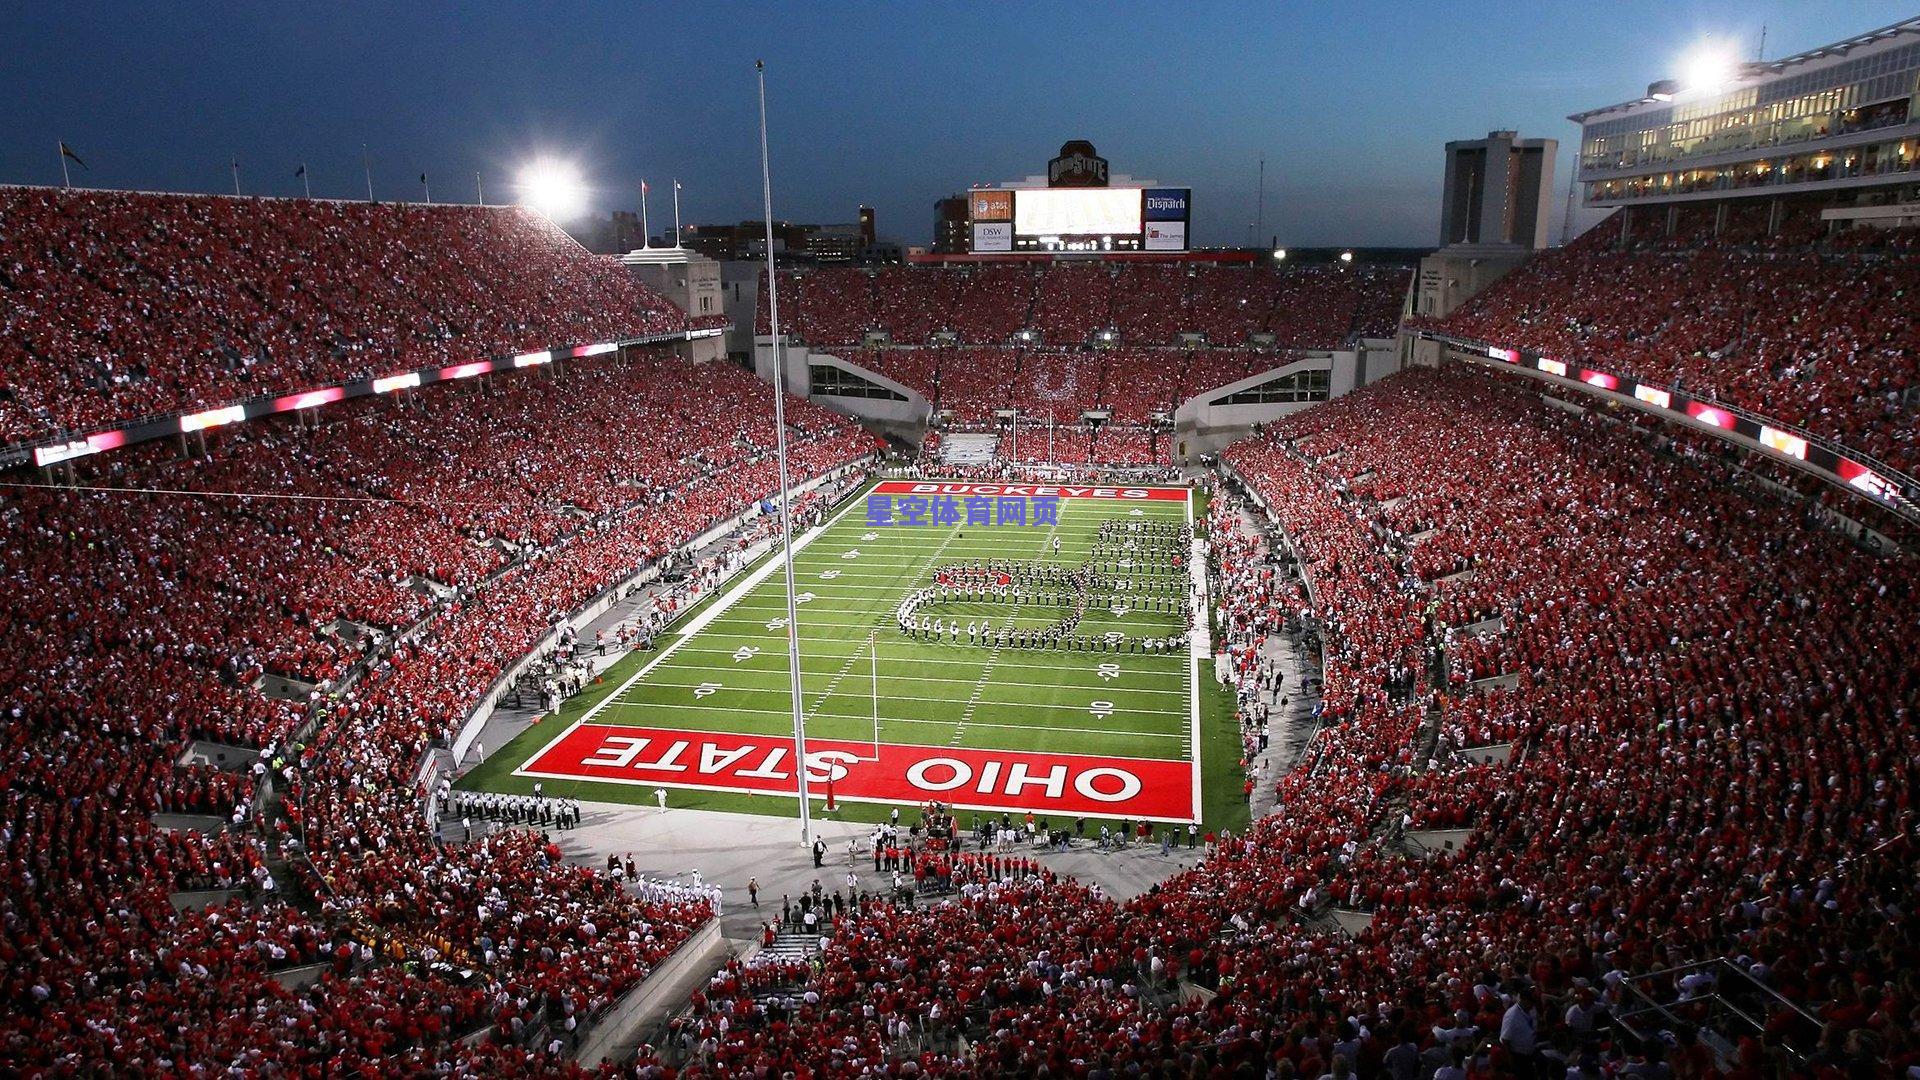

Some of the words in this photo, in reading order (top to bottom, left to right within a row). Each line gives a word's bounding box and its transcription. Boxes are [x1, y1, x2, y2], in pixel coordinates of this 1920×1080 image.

[1147, 197, 1186, 211] Dispatch
[983, 228, 1003, 236] DSW
[911, 484, 1149, 497] BUCKEYES
[733, 646, 760, 658] 20
[1097, 663, 1120, 678] 20
[694, 683, 722, 695] 10
[1089, 701, 1114, 715] 10
[580, 736, 859, 783] STATE
[906, 757, 1142, 802] OHIO
